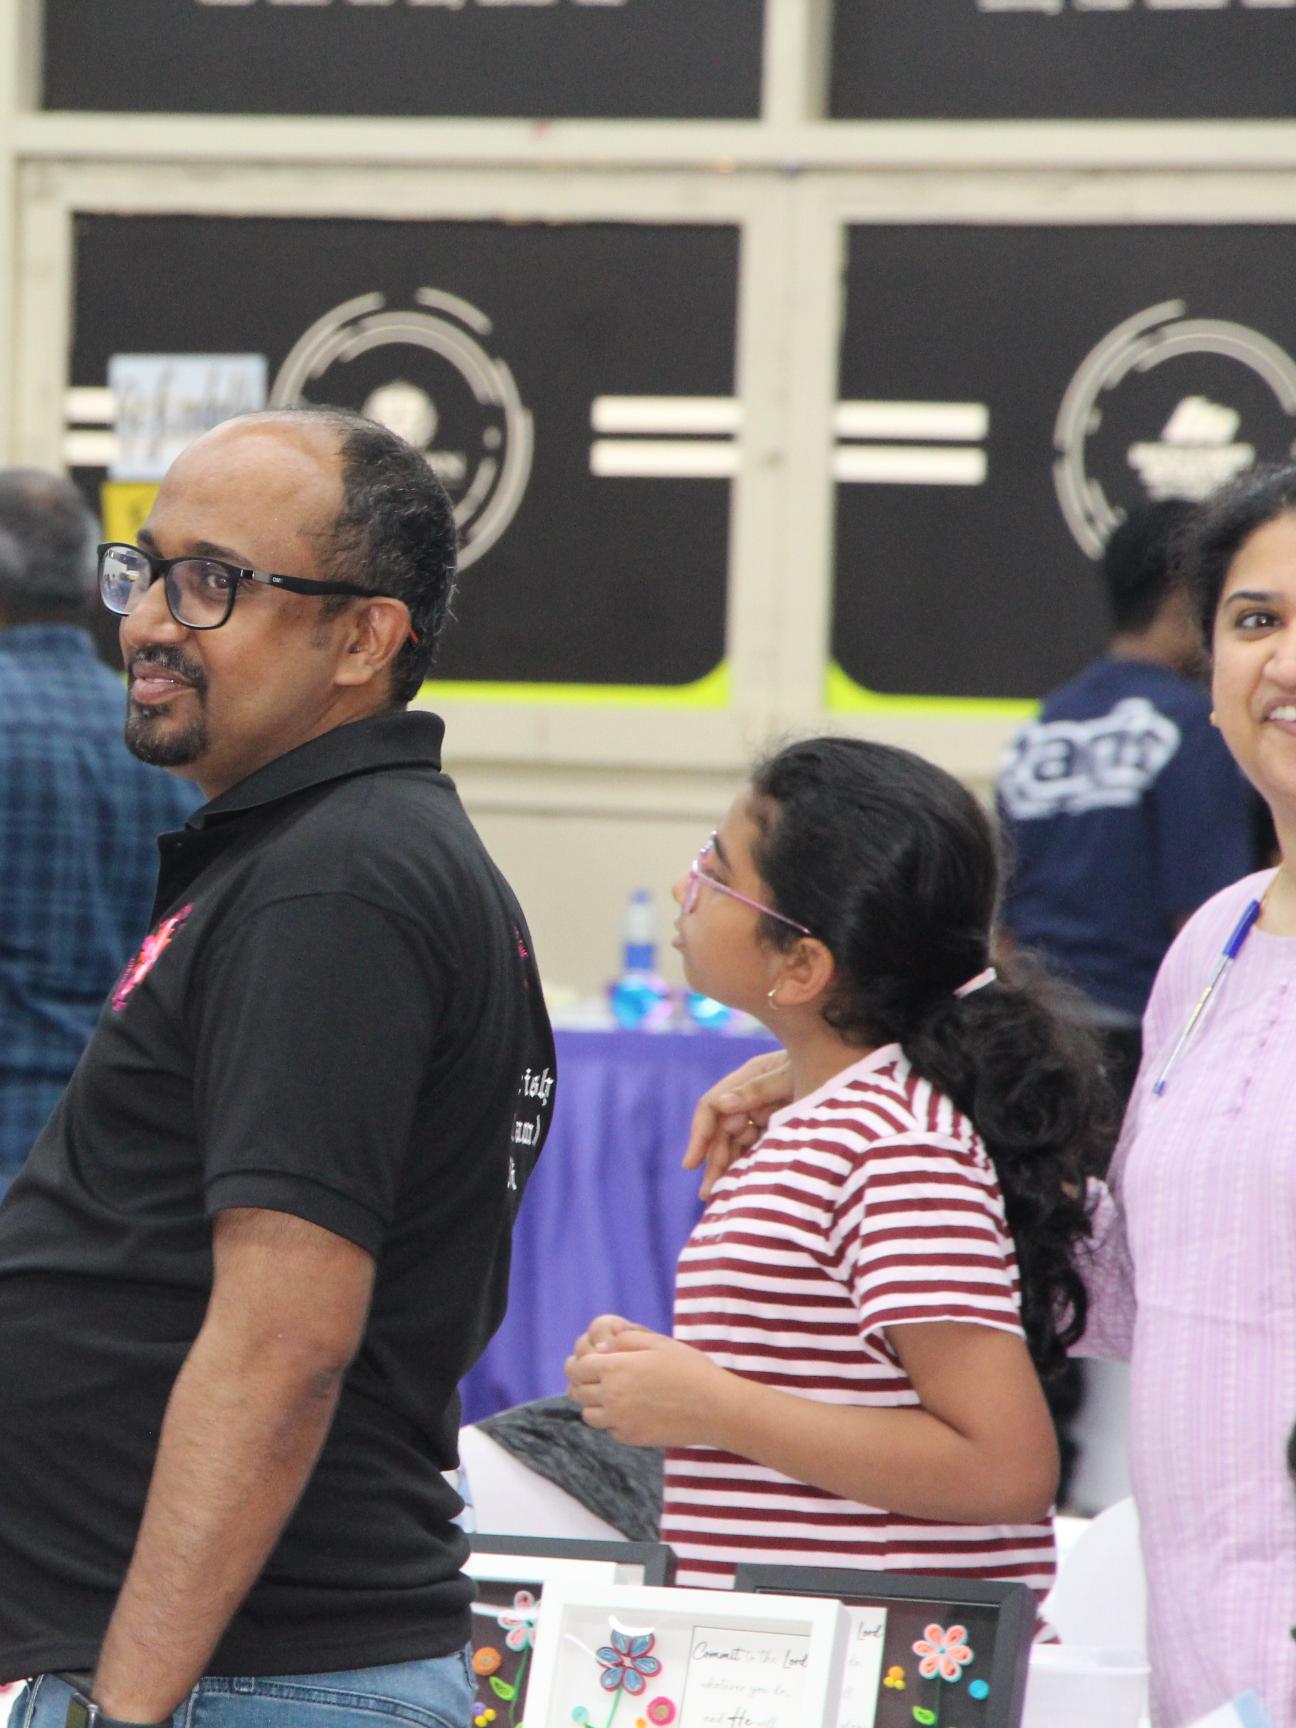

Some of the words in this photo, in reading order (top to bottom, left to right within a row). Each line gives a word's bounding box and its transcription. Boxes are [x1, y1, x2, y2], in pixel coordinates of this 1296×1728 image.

[518, 1067, 554, 1106] ish
[692, 1640, 746, 1661] Commit
[783, 1648, 809, 1669] Lord
[726, 1706, 752, 1728] He
